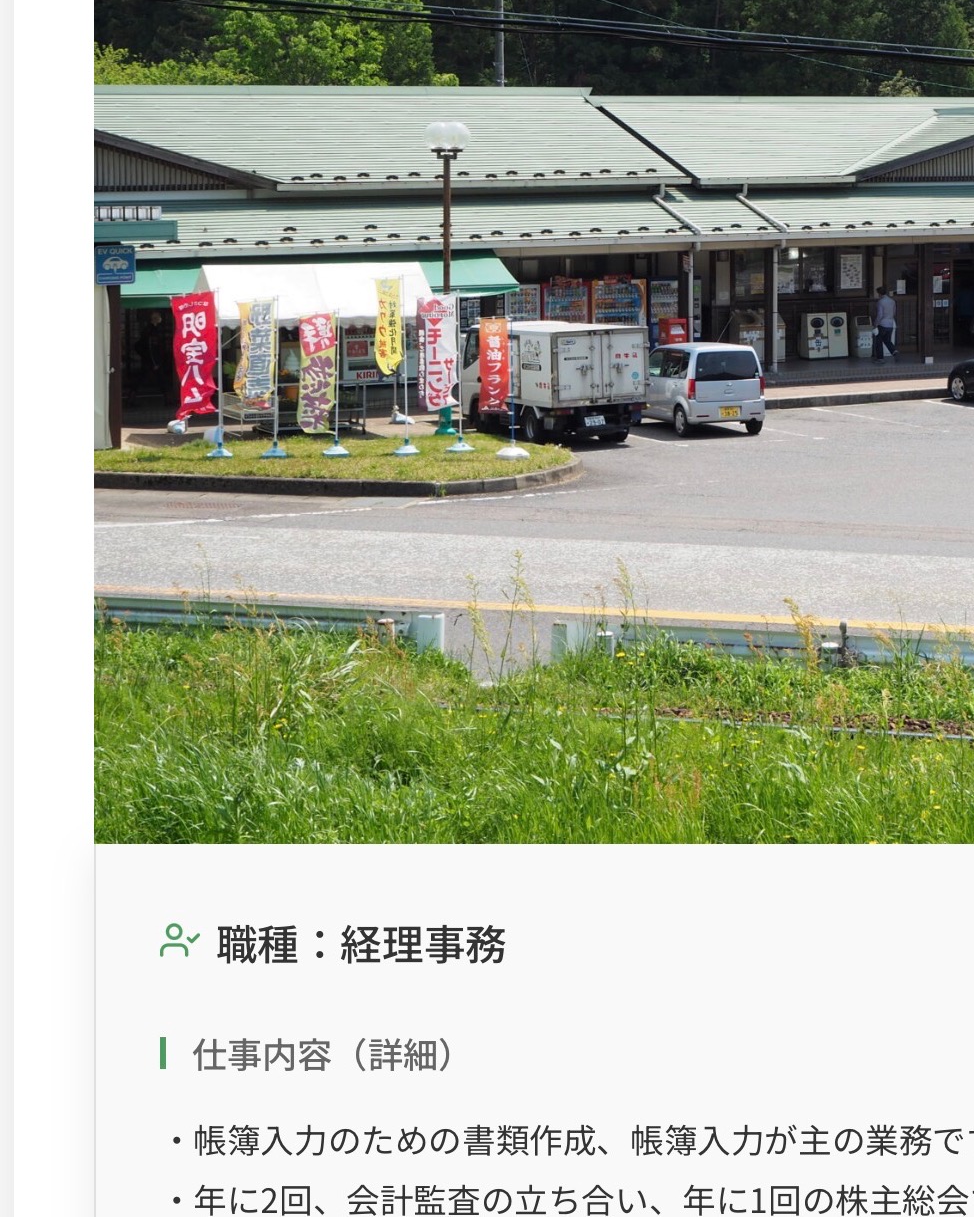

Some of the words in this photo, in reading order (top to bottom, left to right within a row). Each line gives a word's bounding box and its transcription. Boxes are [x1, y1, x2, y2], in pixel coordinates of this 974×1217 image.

[216, 924, 507, 965] 職種：経理事務
[192, 1037, 450, 1073] 仕事内容（詳細）
